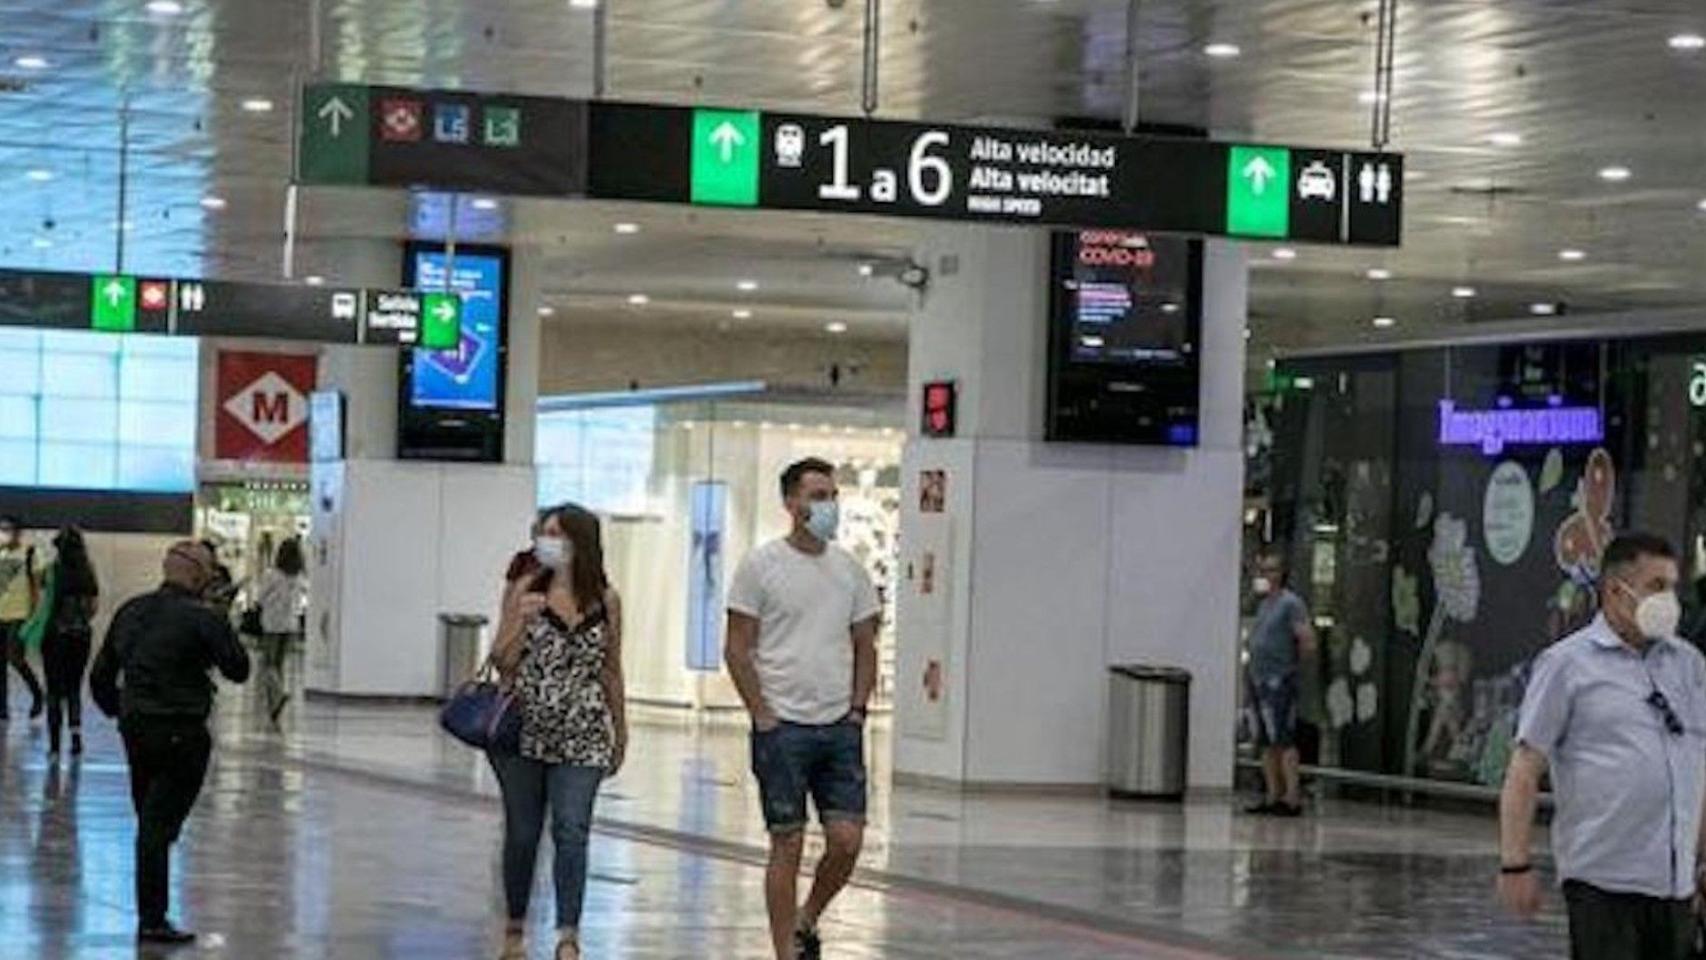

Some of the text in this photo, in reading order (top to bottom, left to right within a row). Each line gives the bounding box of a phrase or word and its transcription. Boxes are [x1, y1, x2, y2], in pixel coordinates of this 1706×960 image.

[819, 125, 951, 206] 1 a 6
[970, 137, 1116, 168] Alta velocidad
[969, 166, 1110, 197] Alta velocitat
[254, 393, 289, 424] M
